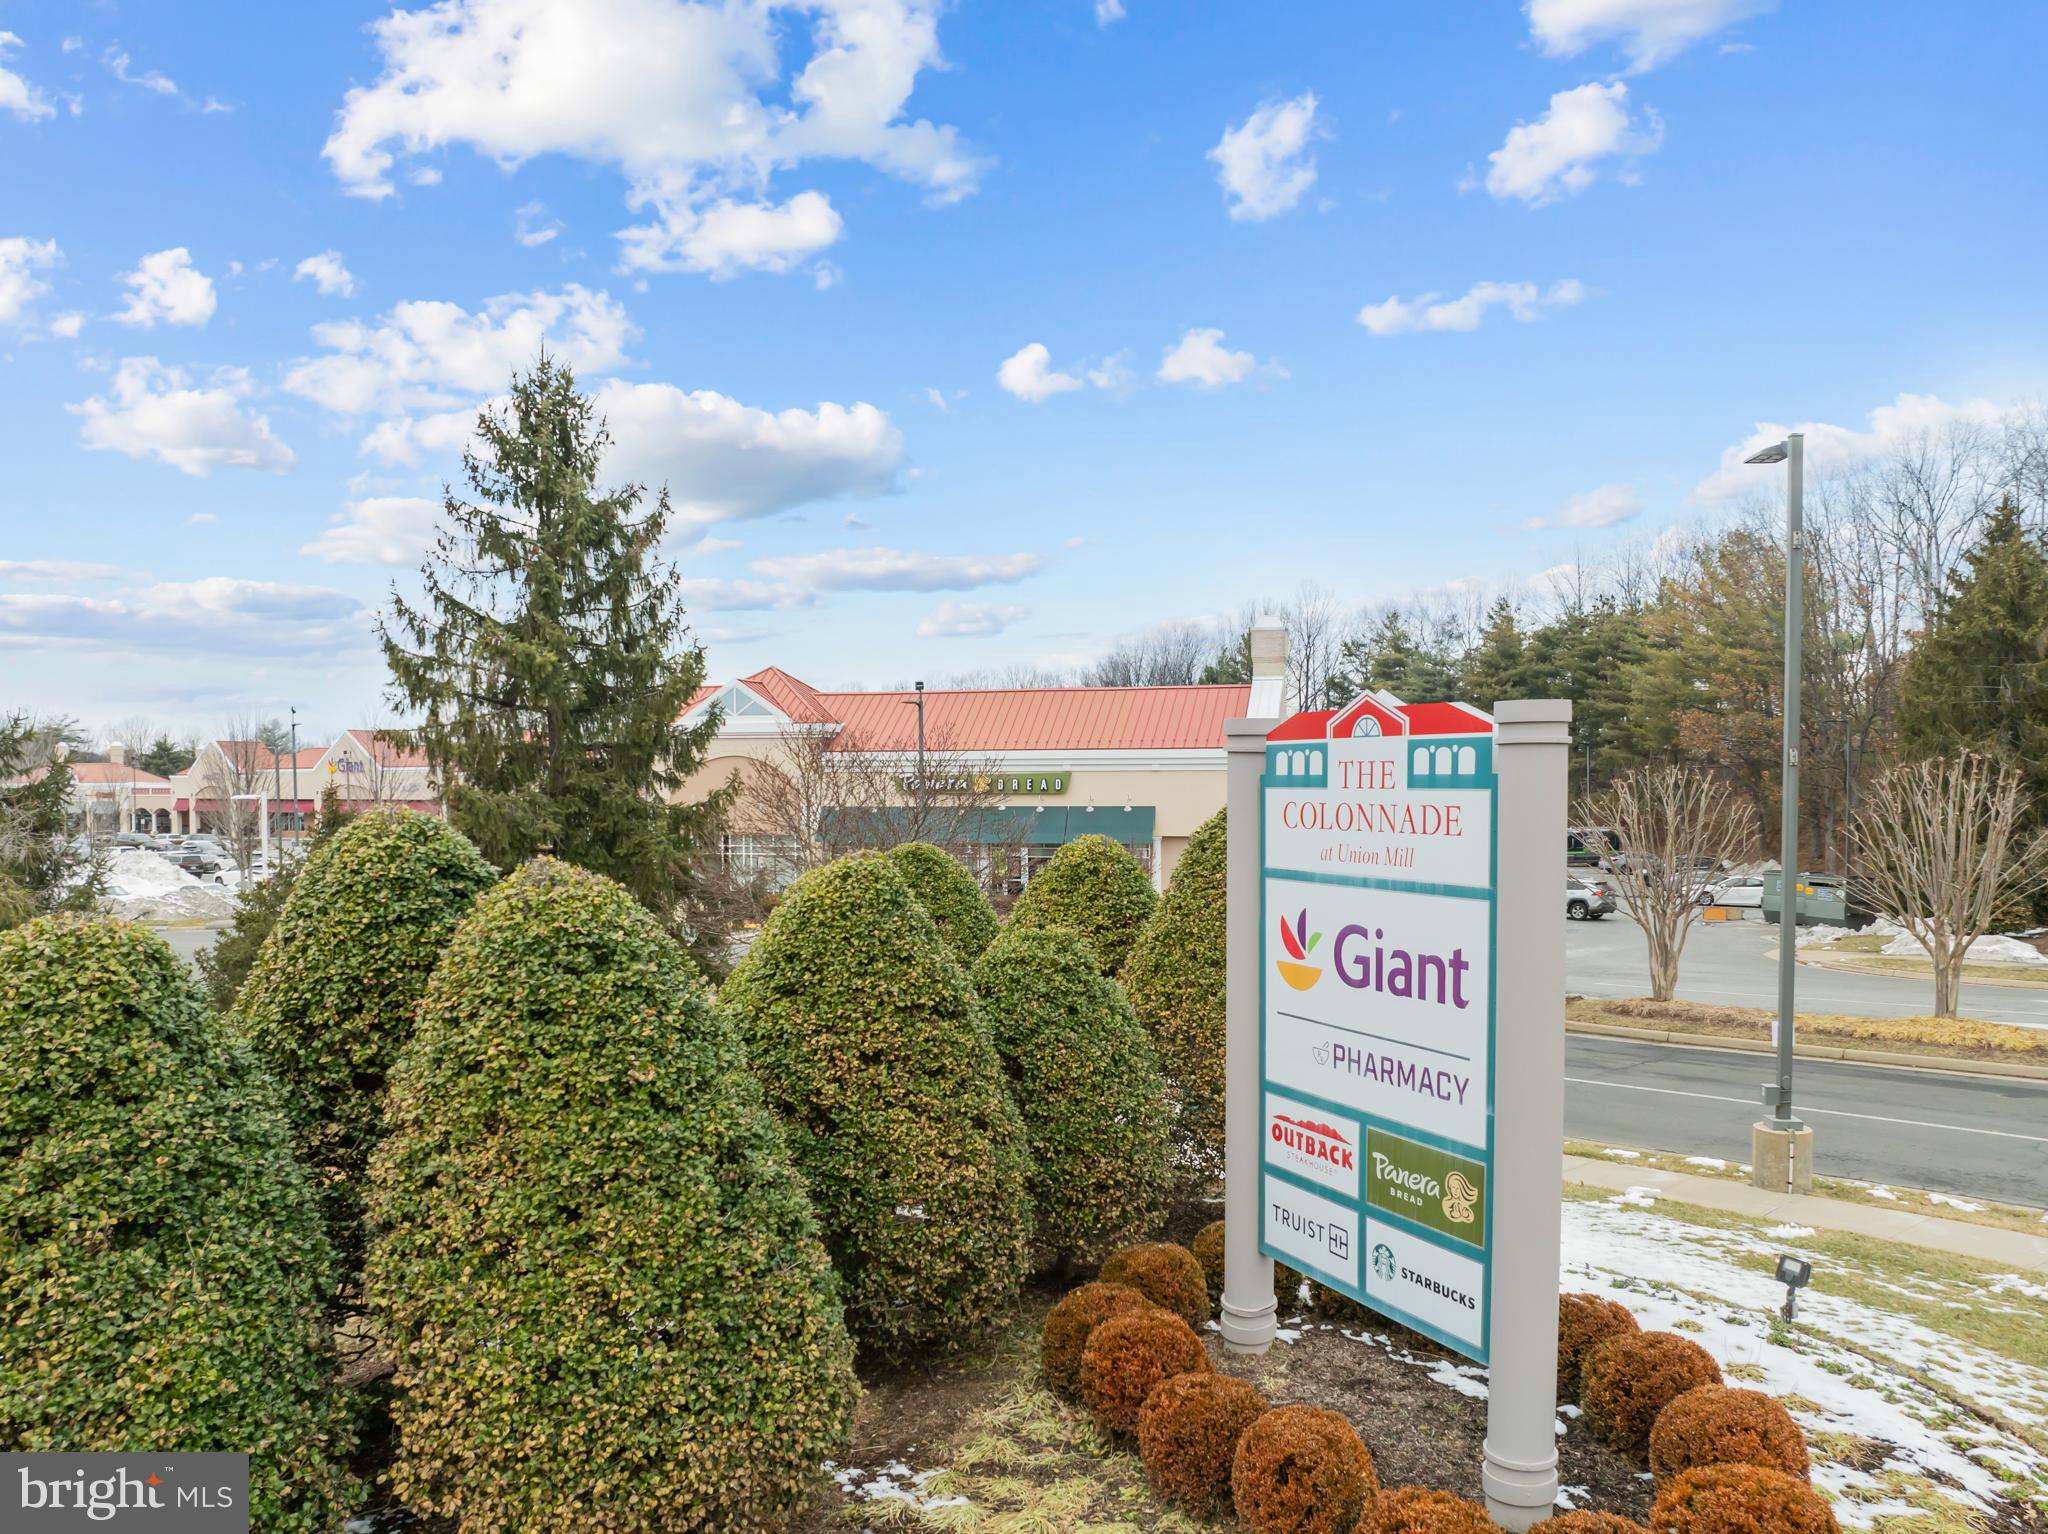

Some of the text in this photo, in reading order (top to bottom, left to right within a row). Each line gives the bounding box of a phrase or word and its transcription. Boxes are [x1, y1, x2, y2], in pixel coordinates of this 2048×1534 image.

[997, 778, 1063, 791] BREAD
[1338, 760, 1396, 790] THE
[1283, 801, 1463, 837] COLONNADE
[1320, 843, 1415, 868] at Union Mill
[1333, 924, 1470, 1009] Giant
[1333, 1043, 1470, 1106] PHARMACY
[1271, 1122, 1353, 1172] OUTBACK
[1286, 1150, 1334, 1177] STEAKHOUSE
[1372, 1151, 1441, 1200] Panera
[1389, 1187, 1424, 1207] BREAD
[1272, 1203, 1325, 1243] TRUIST
[1400, 1266, 1476, 1311] STARBUCKS
